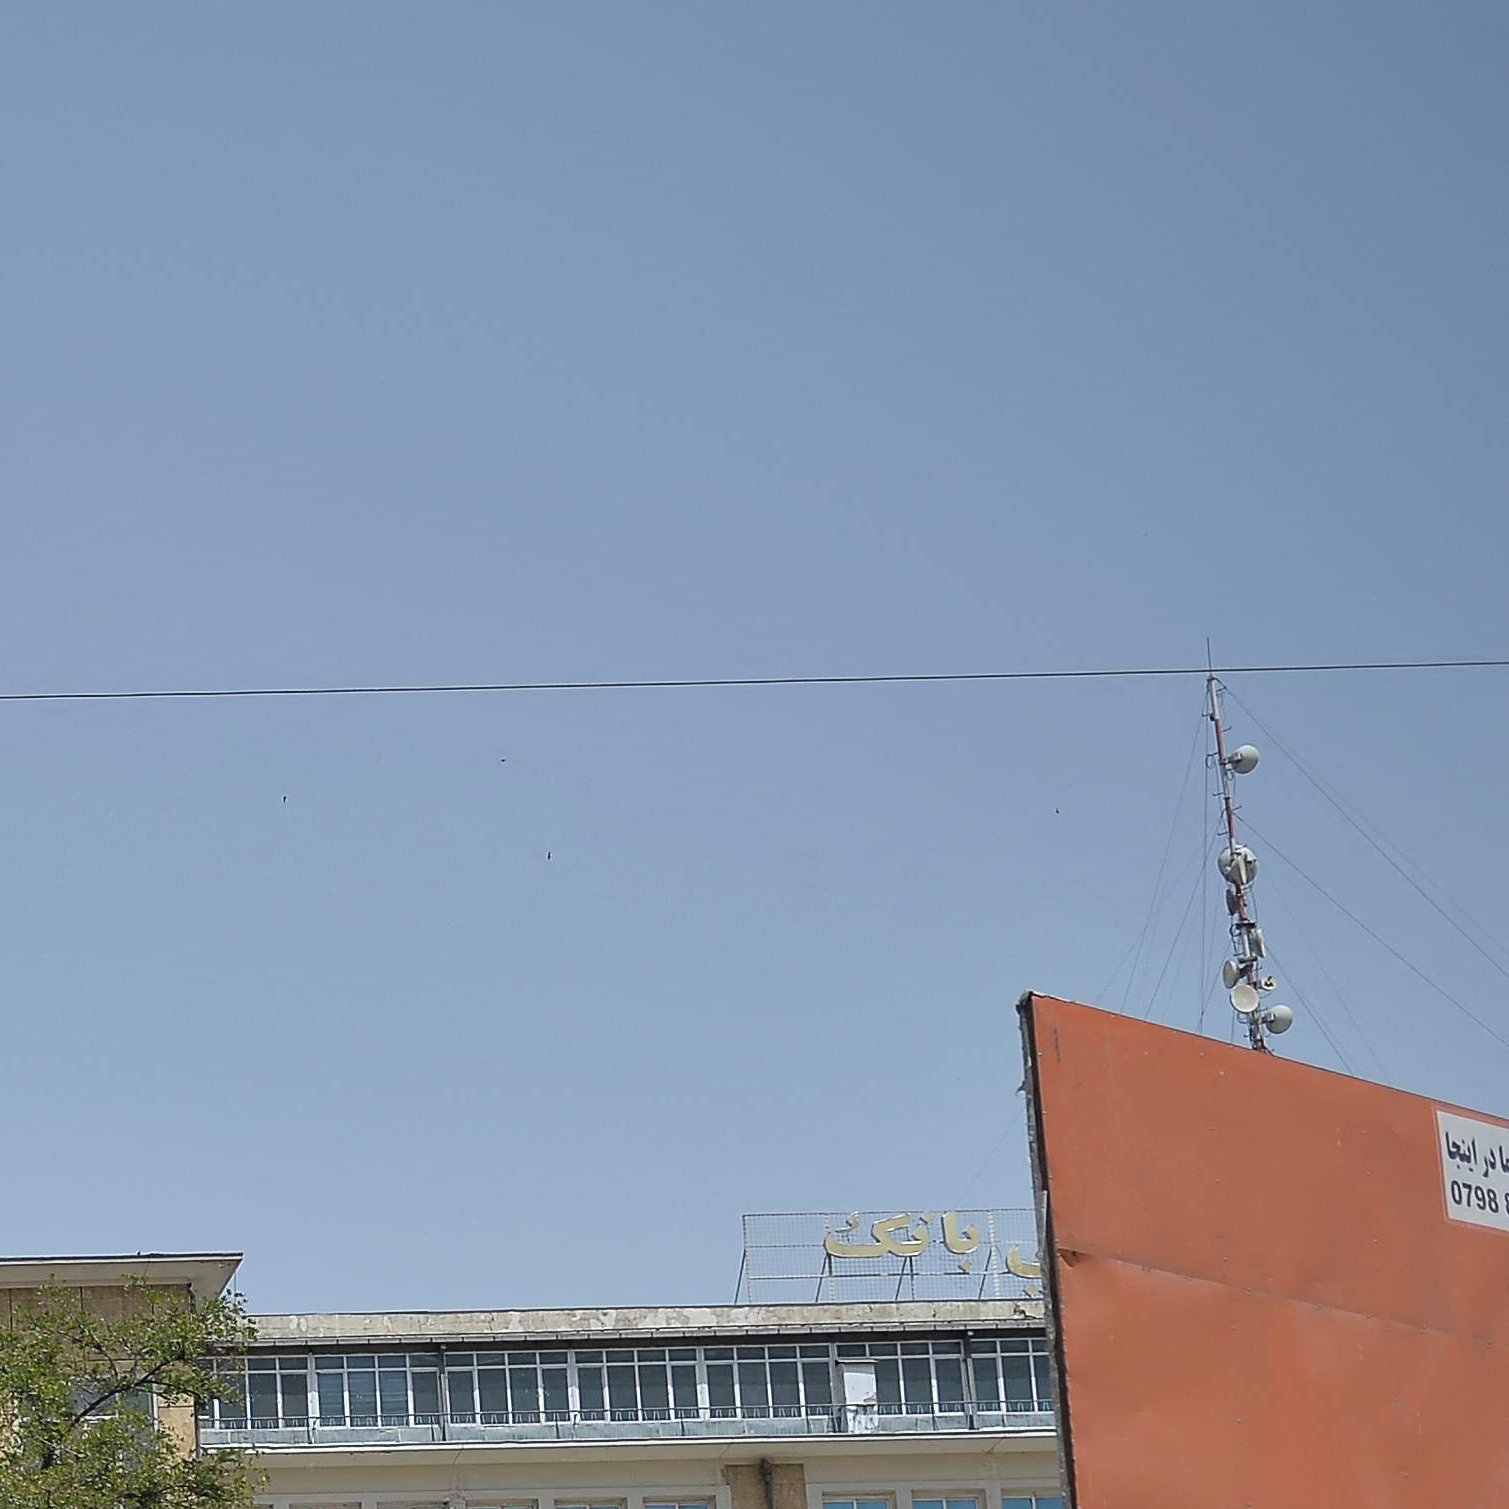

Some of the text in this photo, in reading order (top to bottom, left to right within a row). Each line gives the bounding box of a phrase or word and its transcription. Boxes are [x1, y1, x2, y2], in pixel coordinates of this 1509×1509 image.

[1445, 1131, 1478, 1173] اینجا
[1482, 1147, 1497, 1178] در
[1450, 1180, 1500, 1214] 0798
